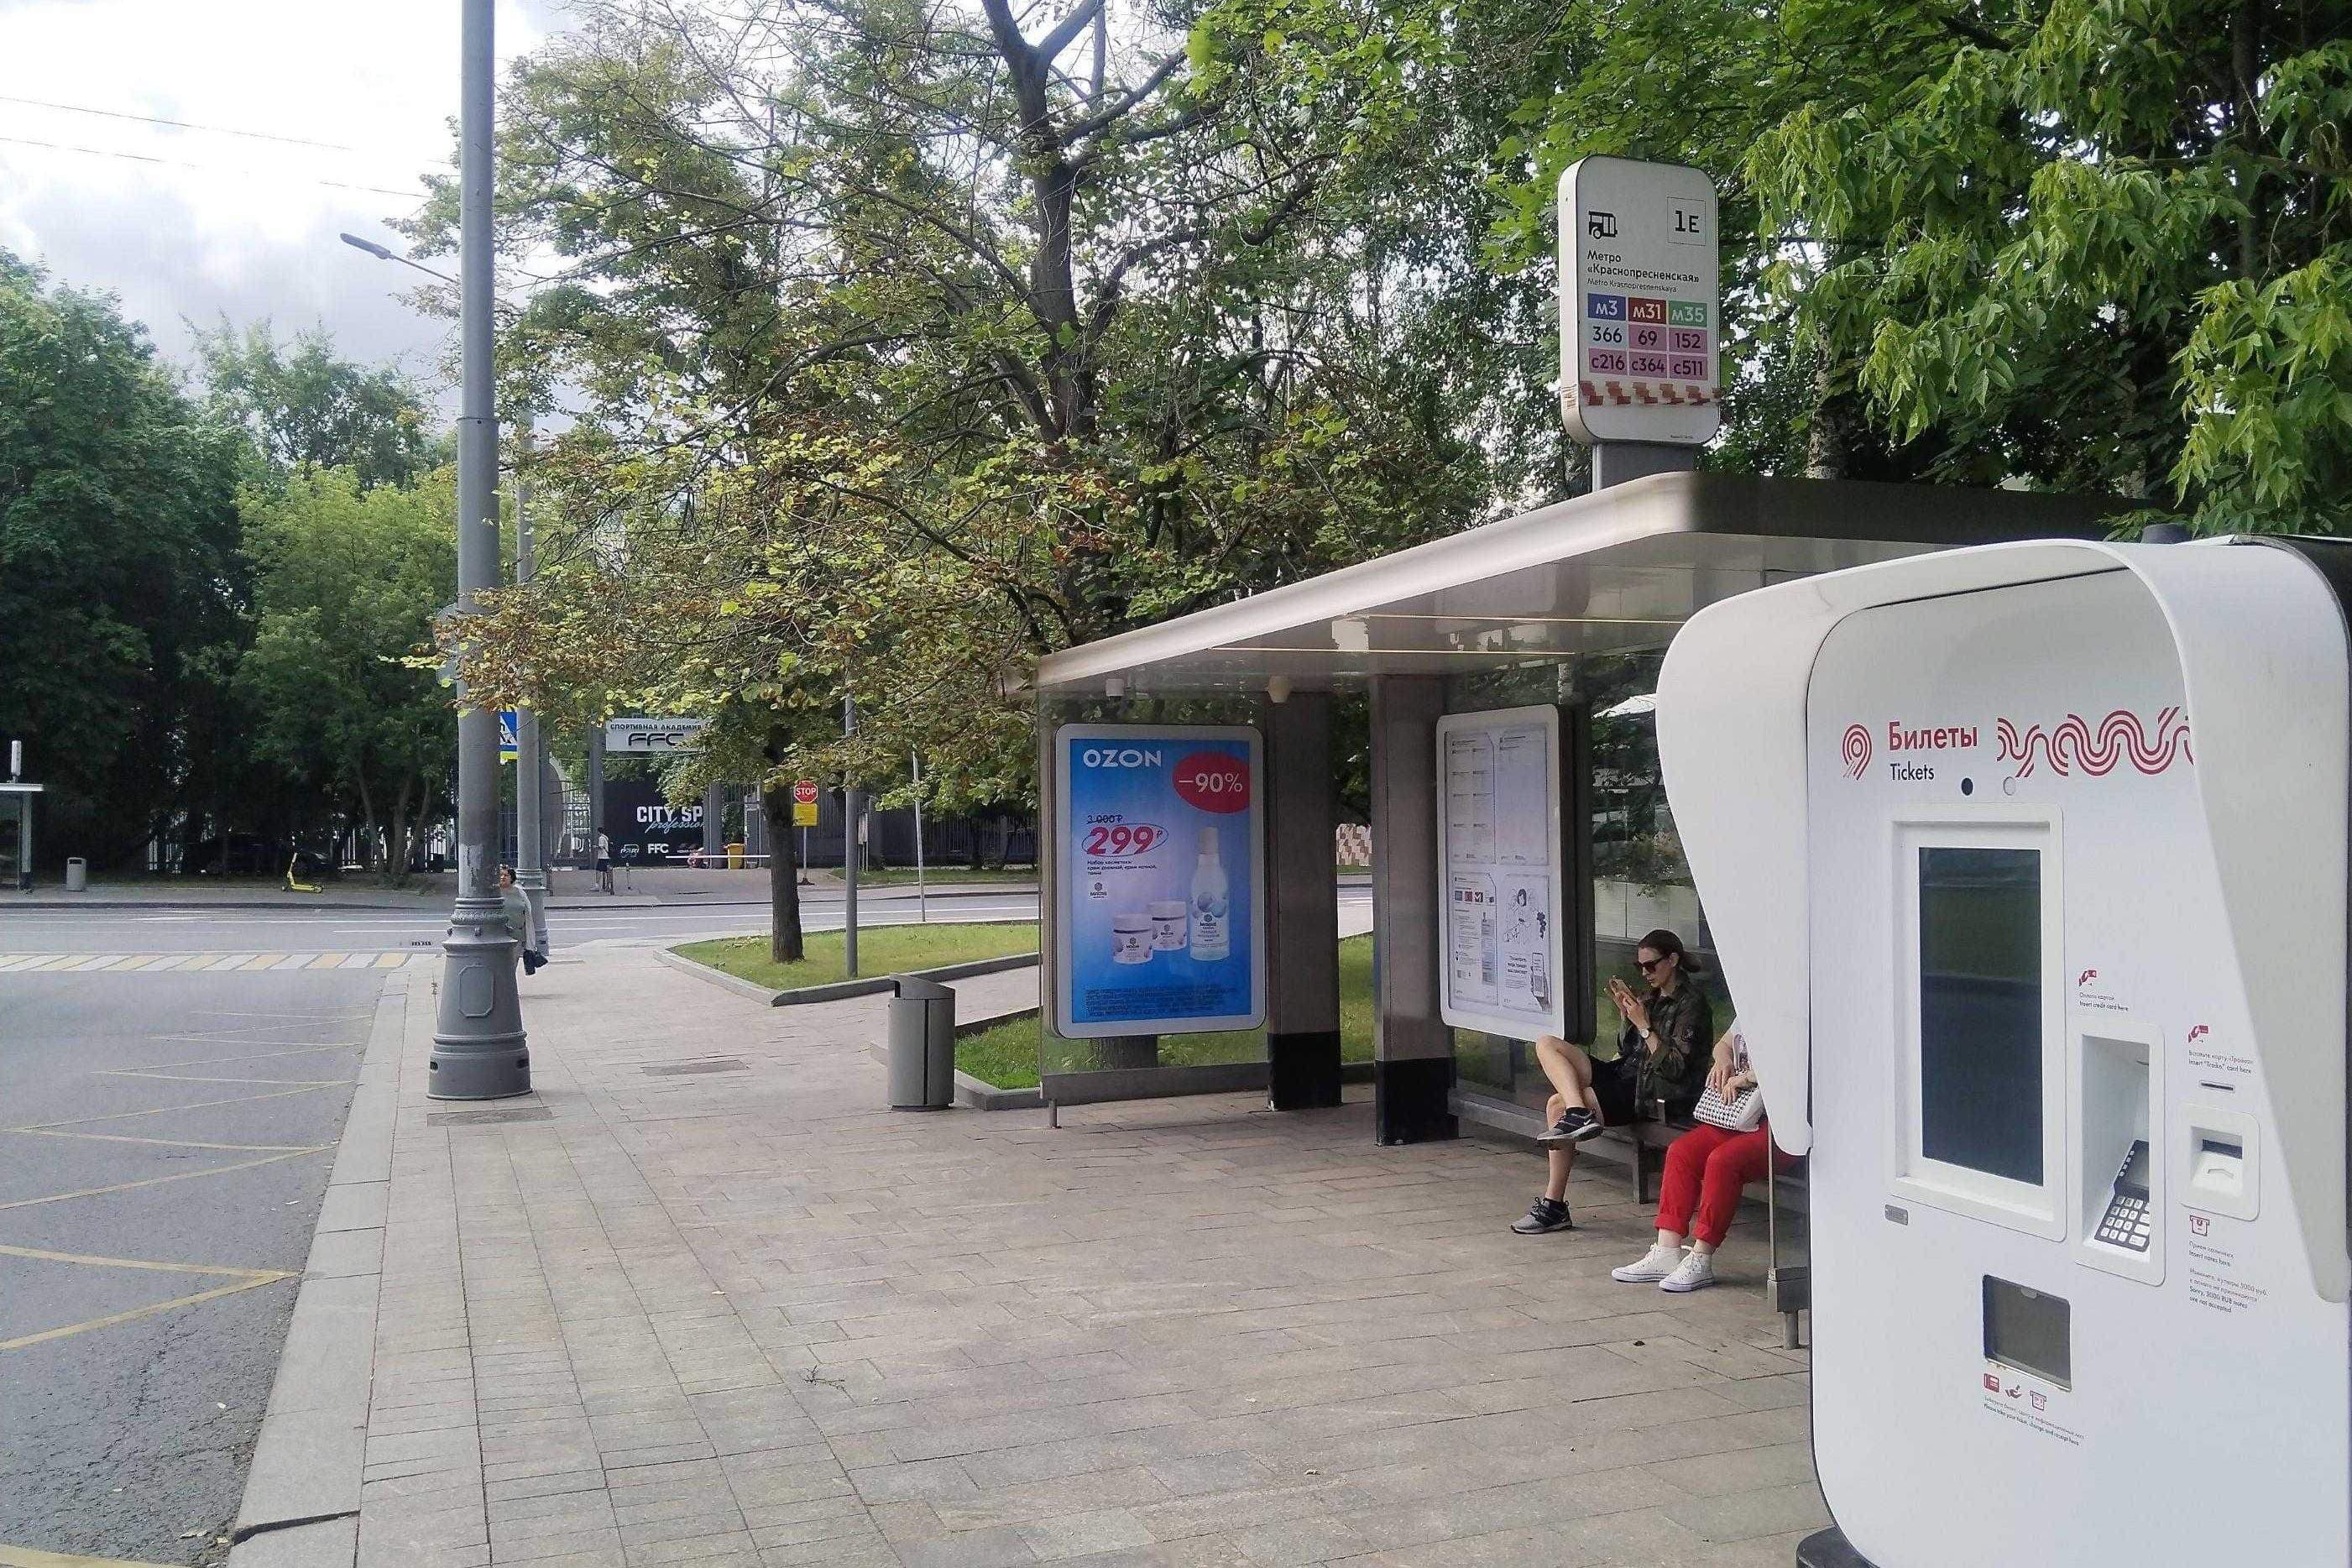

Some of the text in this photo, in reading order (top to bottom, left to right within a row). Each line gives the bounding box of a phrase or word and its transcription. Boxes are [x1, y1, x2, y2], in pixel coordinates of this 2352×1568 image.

[1586, 249, 1622, 264] Метро
[1586, 263, 1700, 283] «Краснопресненская»
[1586, 278, 1677, 293] Metro Krasnopresnenskaya
[1592, 326, 1701, 349] 366 69 152
[628, 732, 684, 746] FFC
[1888, 720, 1978, 751] Билеты
[1083, 749, 1162, 768] OZON
[1889, 761, 1935, 781] Tickets
[796, 787, 817, 796] STOP
[636, 806, 674, 823] CITY
[647, 843, 669, 855] FFC
[2117, 1003, 2129, 1011] here
[2240, 1065, 2251, 1074] here
[2188, 1250, 2203, 1258] Insert
[2219, 1257, 2230, 1267] here
[2189, 1286, 2205, 1297] Sorry,
[2233, 1300, 2248, 1309] notes
[2208, 1302, 2232, 1314] accepted
